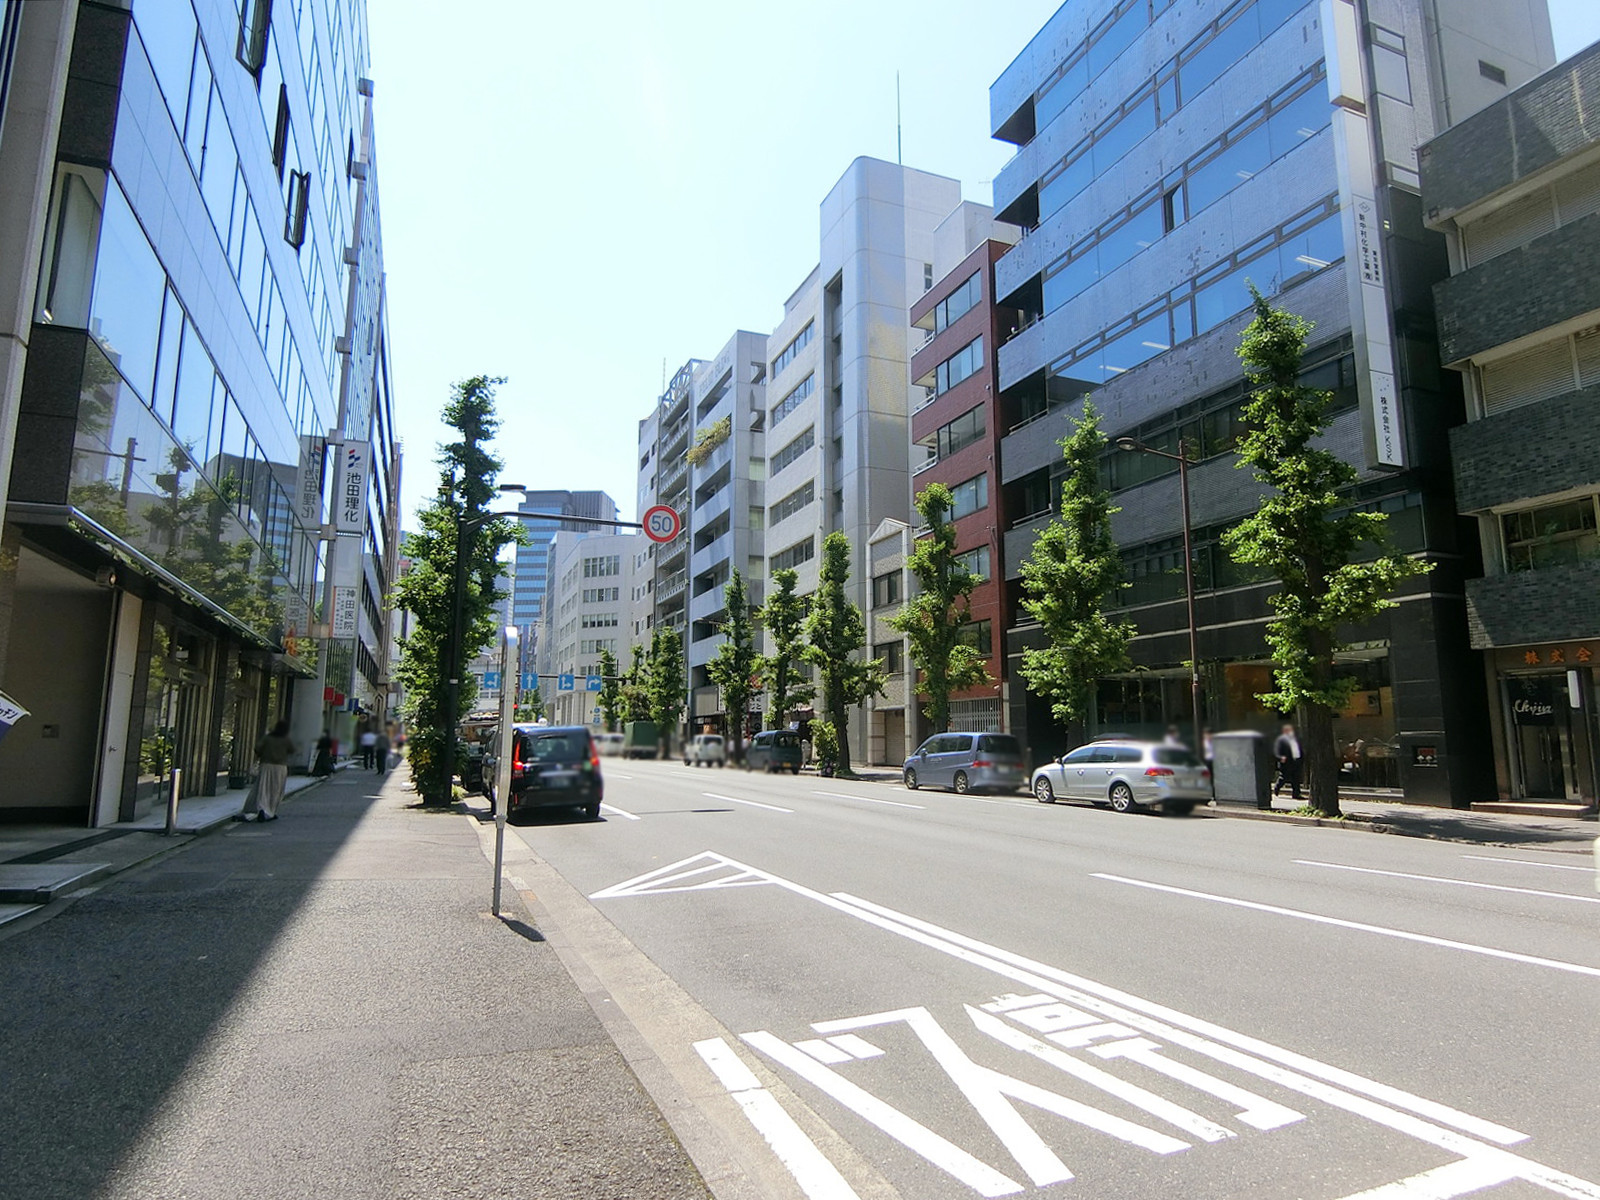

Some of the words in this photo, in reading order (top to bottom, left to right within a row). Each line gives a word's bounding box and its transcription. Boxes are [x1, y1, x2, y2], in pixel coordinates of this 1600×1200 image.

[344, 472, 362, 523] 池田理化
[651, 514, 673, 533] 50
[343, 589, 356, 631] 神田医院
